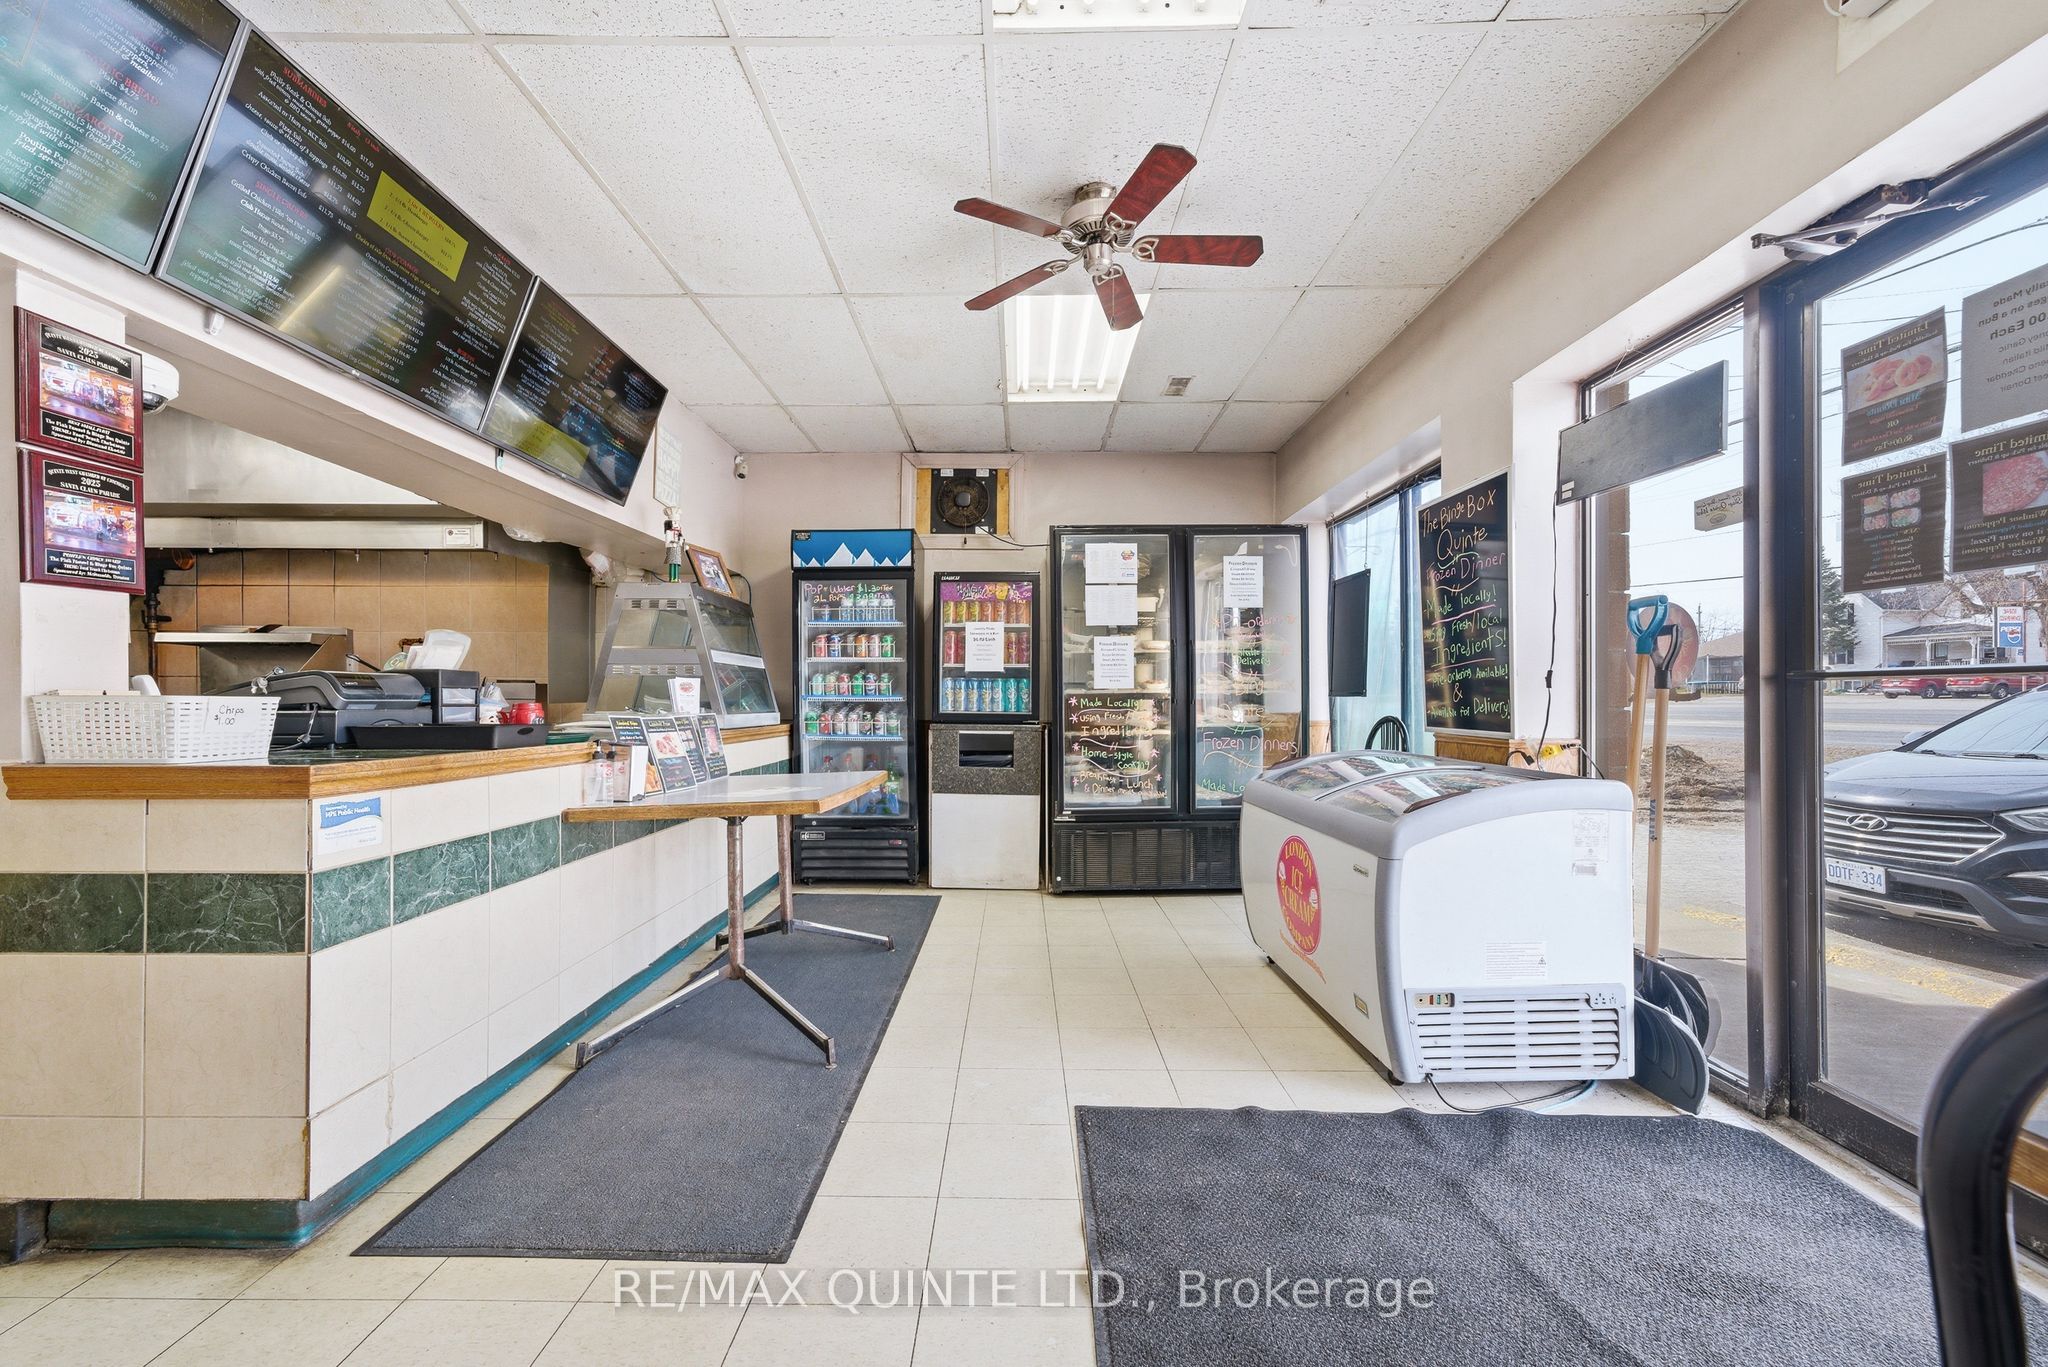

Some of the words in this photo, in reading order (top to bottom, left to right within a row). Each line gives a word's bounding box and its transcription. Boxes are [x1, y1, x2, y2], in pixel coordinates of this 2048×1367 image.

[57, 347, 76, 358] SANTA
[77, 355, 96, 365] CLAUS
[97, 361, 119, 373] PARADE
[60, 481, 79, 490] SANTA
[80, 486, 99, 494] CLAUS
[99, 490, 120, 499] PARADE
[1422, 509, 1439, 538] The
[1440, 502, 1464, 530] Binge
[1437, 526, 1488, 560] Quinte
[1461, 553, 1505, 579] Dinner
[1461, 583, 1496, 608] locally!
[1475, 664, 1508, 679] Available!
[1080, 697, 1102, 708] Made
[1453, 683, 1463, 703] &
[219, 704, 244, 716] Chips
[1473, 697, 1511, 720] Delivery!
[1203, 732, 1244, 752] Frozen
[1250, 736, 1298, 755] Dinners
[1201, 778, 1226, 792] Made
[1285, 841, 1314, 878] LONDON
[1291, 865, 1304, 895] ICE
[1862, 871, 1882, 886] 334
